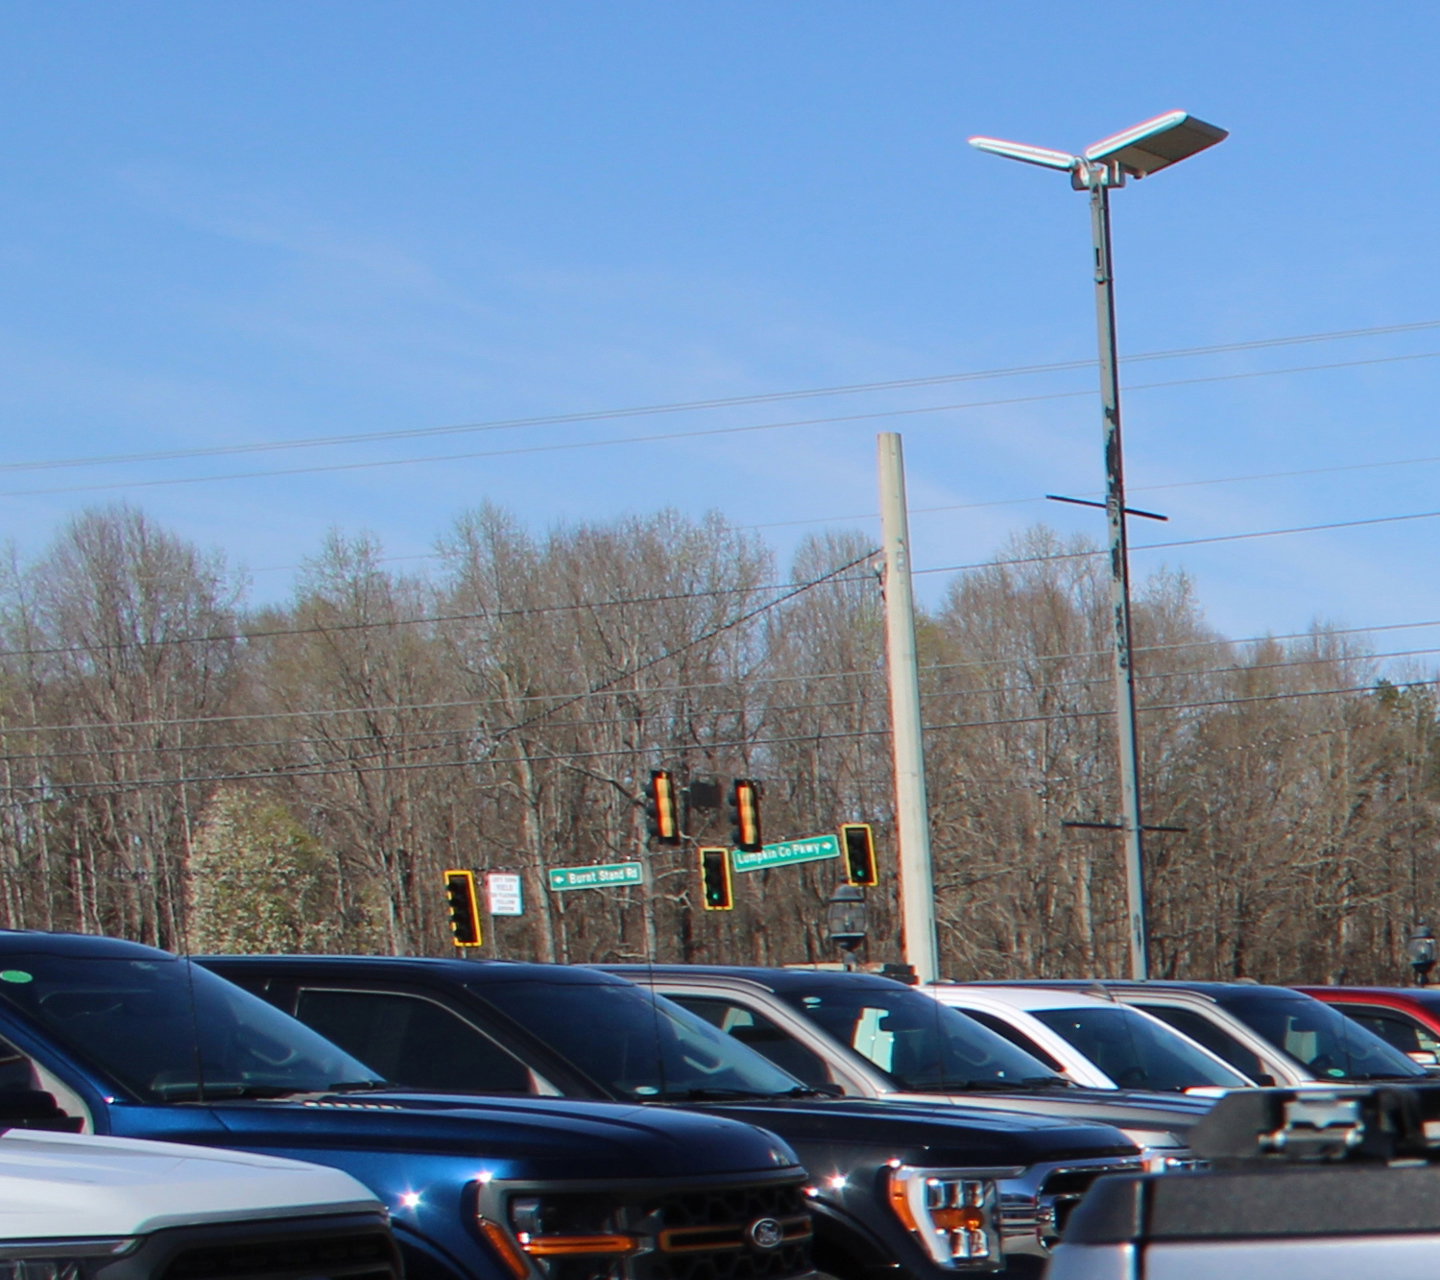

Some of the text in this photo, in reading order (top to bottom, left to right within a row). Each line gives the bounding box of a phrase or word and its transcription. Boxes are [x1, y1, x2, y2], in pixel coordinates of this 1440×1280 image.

[736, 842, 820, 865] Lumpkin Co Pkwy
[568, 867, 638, 885] Burnt Stand Rd
